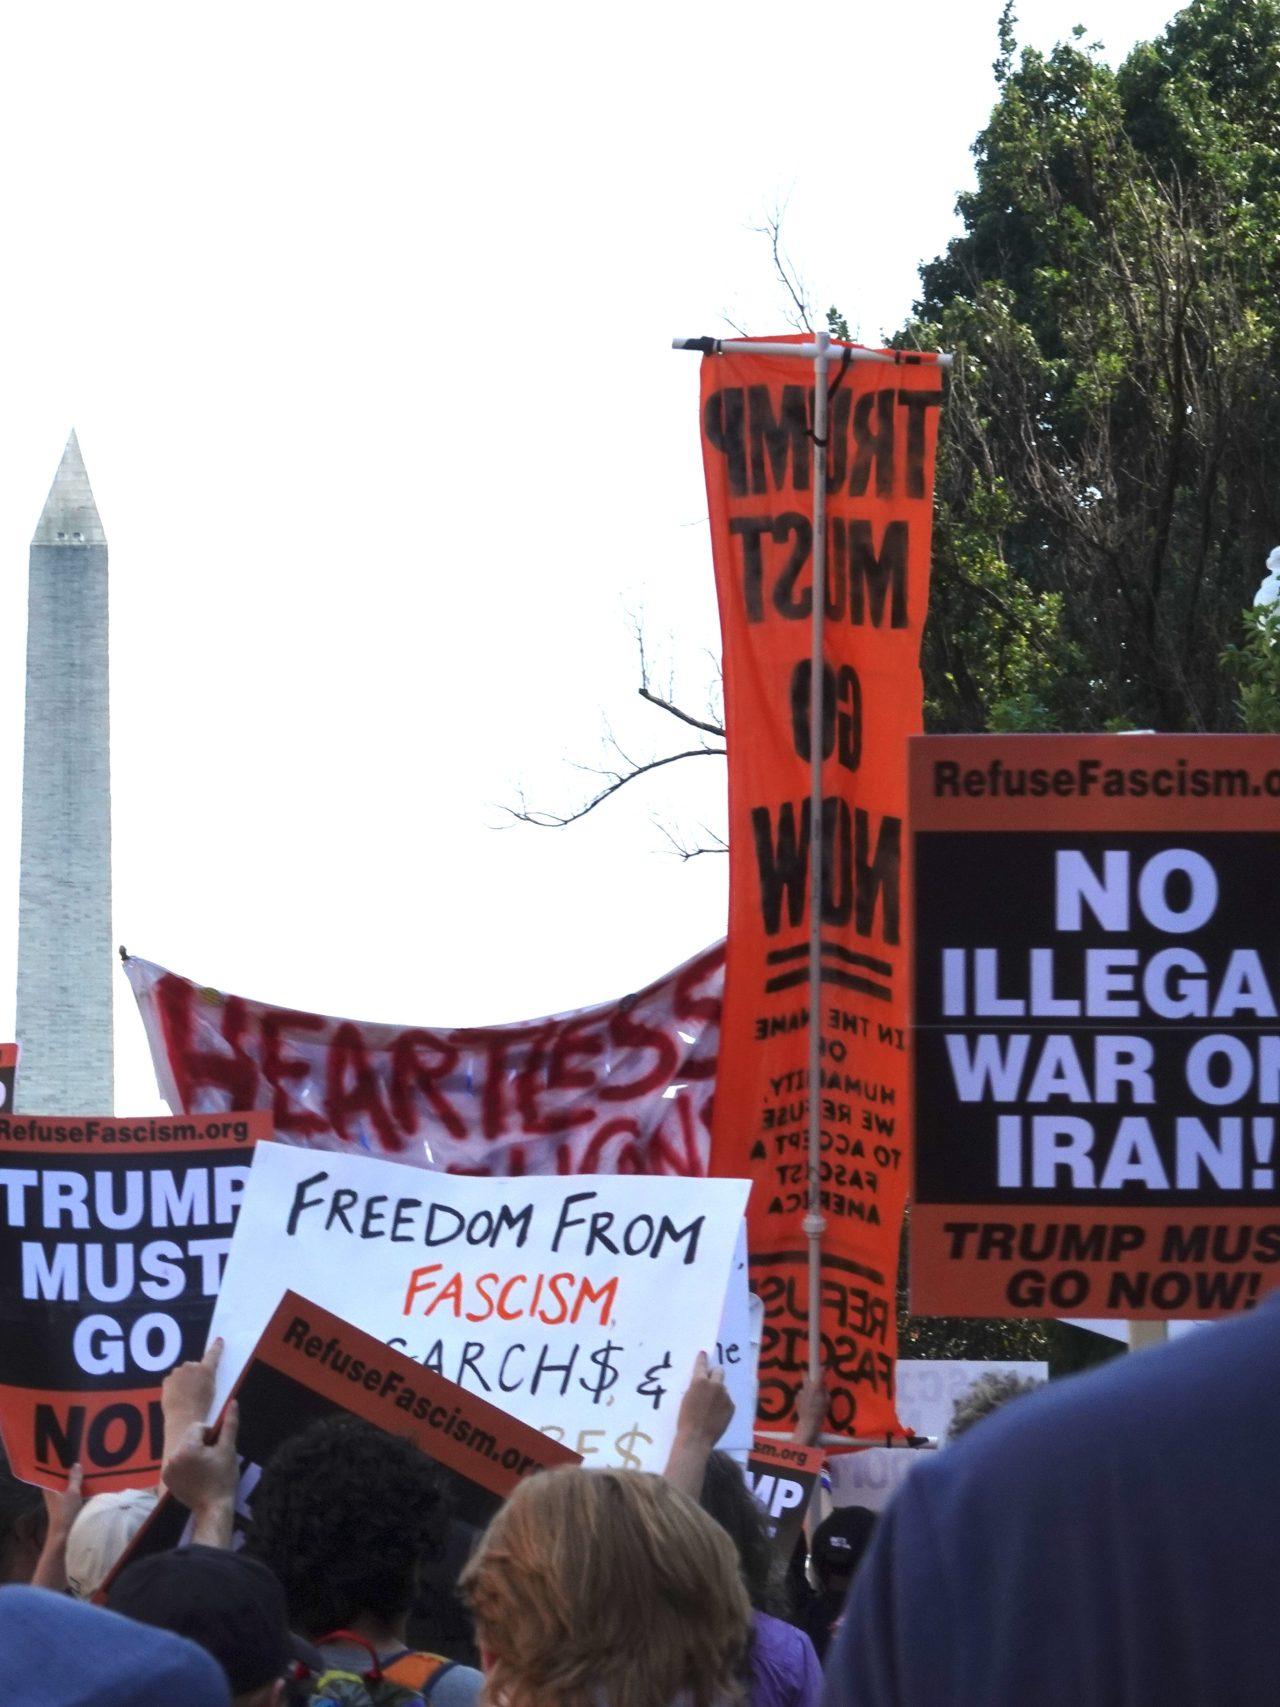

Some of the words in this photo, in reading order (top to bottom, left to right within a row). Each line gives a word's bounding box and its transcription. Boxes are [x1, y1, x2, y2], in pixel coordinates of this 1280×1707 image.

[933, 759, 1280, 798] RefuseFascism.o
[1055, 848, 1219, 934] NO
[941, 947, 1278, 1019] ILLEGA
[945, 1034, 1156, 1104] WAR
[996, 1115, 1275, 1190] IRAN!
[286, 1171, 534, 1248] FREEDOM
[551, 1191, 705, 1265] FROM
[942, 1223, 1145, 1262] TRUMP
[1160, 1225, 1280, 1264] MUS
[22, 1238, 231, 1302] MUST
[1005, 1269, 1089, 1309] GO
[1107, 1271, 1262, 1310] NOW!
[73, 1312, 182, 1377] GO
[635, 1351, 674, 1411] &
